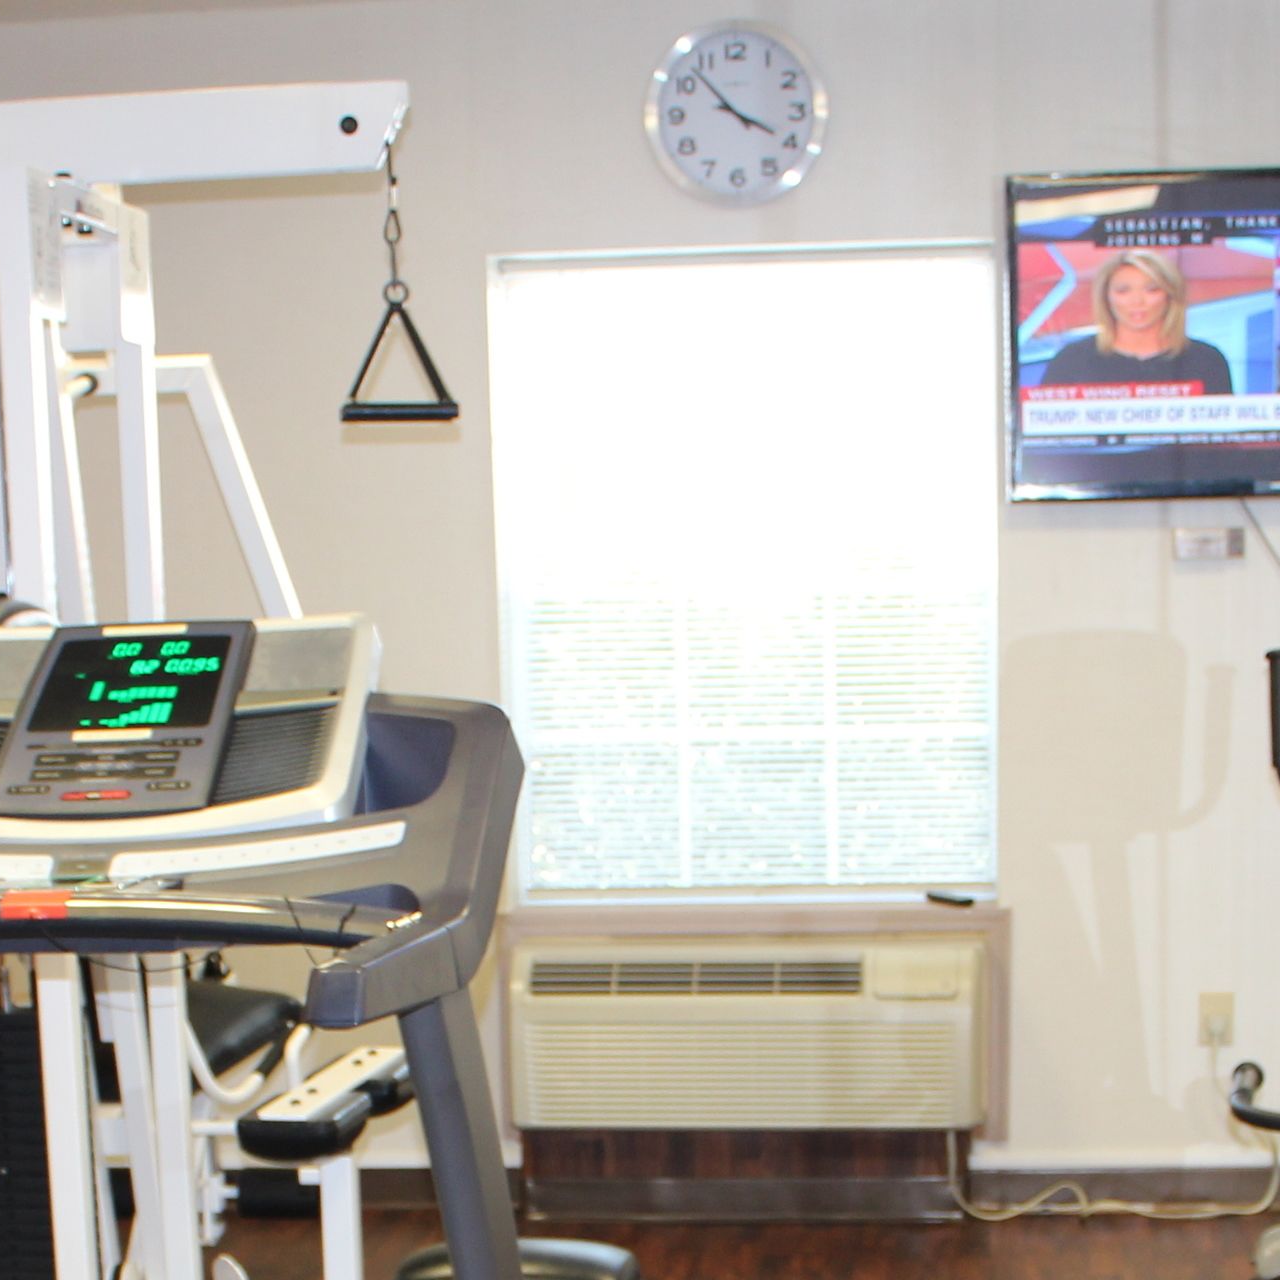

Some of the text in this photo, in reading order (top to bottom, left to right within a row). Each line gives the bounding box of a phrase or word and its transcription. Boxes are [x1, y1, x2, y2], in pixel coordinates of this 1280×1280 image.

[698, 52, 714, 70] 11
[725, 42, 747, 61] 12
[676, 76, 696, 95] 10
[780, 70, 797, 90] 2
[668, 106, 685, 125] 9
[787, 102, 805, 121] 3
[678, 136, 696, 155] 8
[782, 132, 798, 149] 4
[701, 160, 716, 179] 7
[761, 157, 778, 177] 5
[729, 167, 746, 188] 6
[1226, 215, 1277, 229] THANK
[1026, 382, 1191, 400] WEST WING RESET
[1085, 407, 1119, 424] NEW
[1122, 406, 1162, 423] CHIEF
[1170, 405, 1186, 421] OF
[1191, 404, 1230, 421] STAFF
[1237, 403, 1269, 420] WILL
